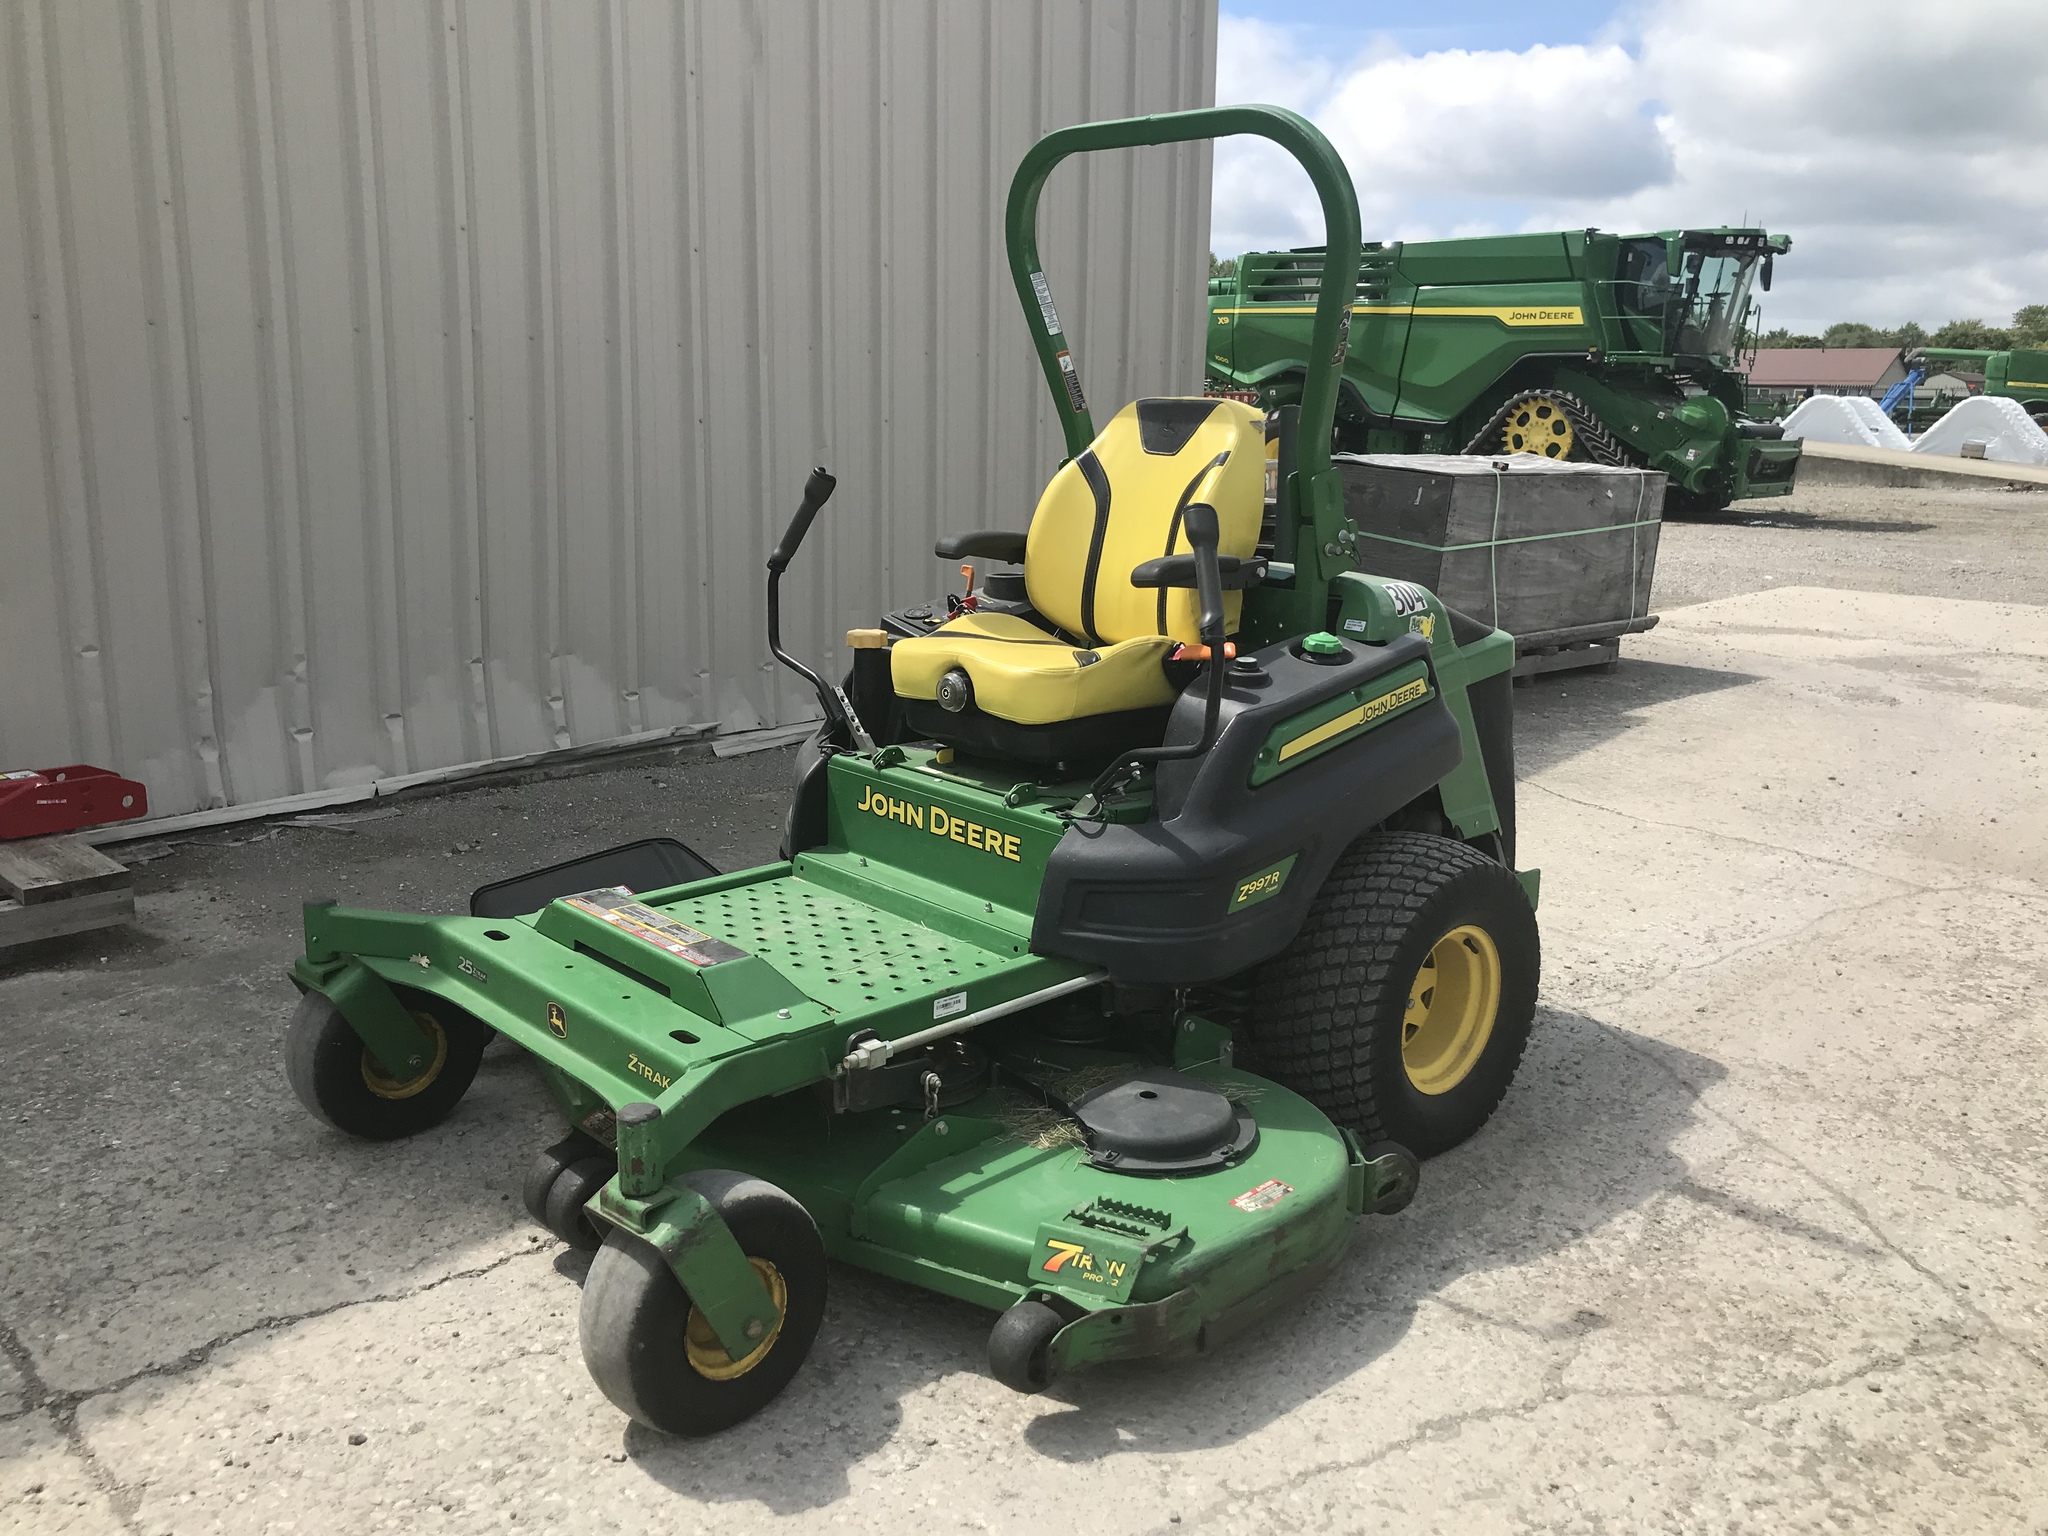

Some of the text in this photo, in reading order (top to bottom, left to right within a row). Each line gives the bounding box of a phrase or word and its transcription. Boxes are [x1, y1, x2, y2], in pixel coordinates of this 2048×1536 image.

[1217, 316, 1230, 325] X9
[1509, 311, 1574, 320] JOHN DEERE
[1384, 583, 1426, 616] 304
[1359, 684, 1421, 723] JOHN DEERE
[857, 785, 1021, 863] JOHN DEERE
[1237, 871, 1280, 902] Z997R
[457, 955, 473, 975] 25
[627, 1053, 671, 1089] ZTRAK
[1082, 1272, 1104, 1283] PRO
